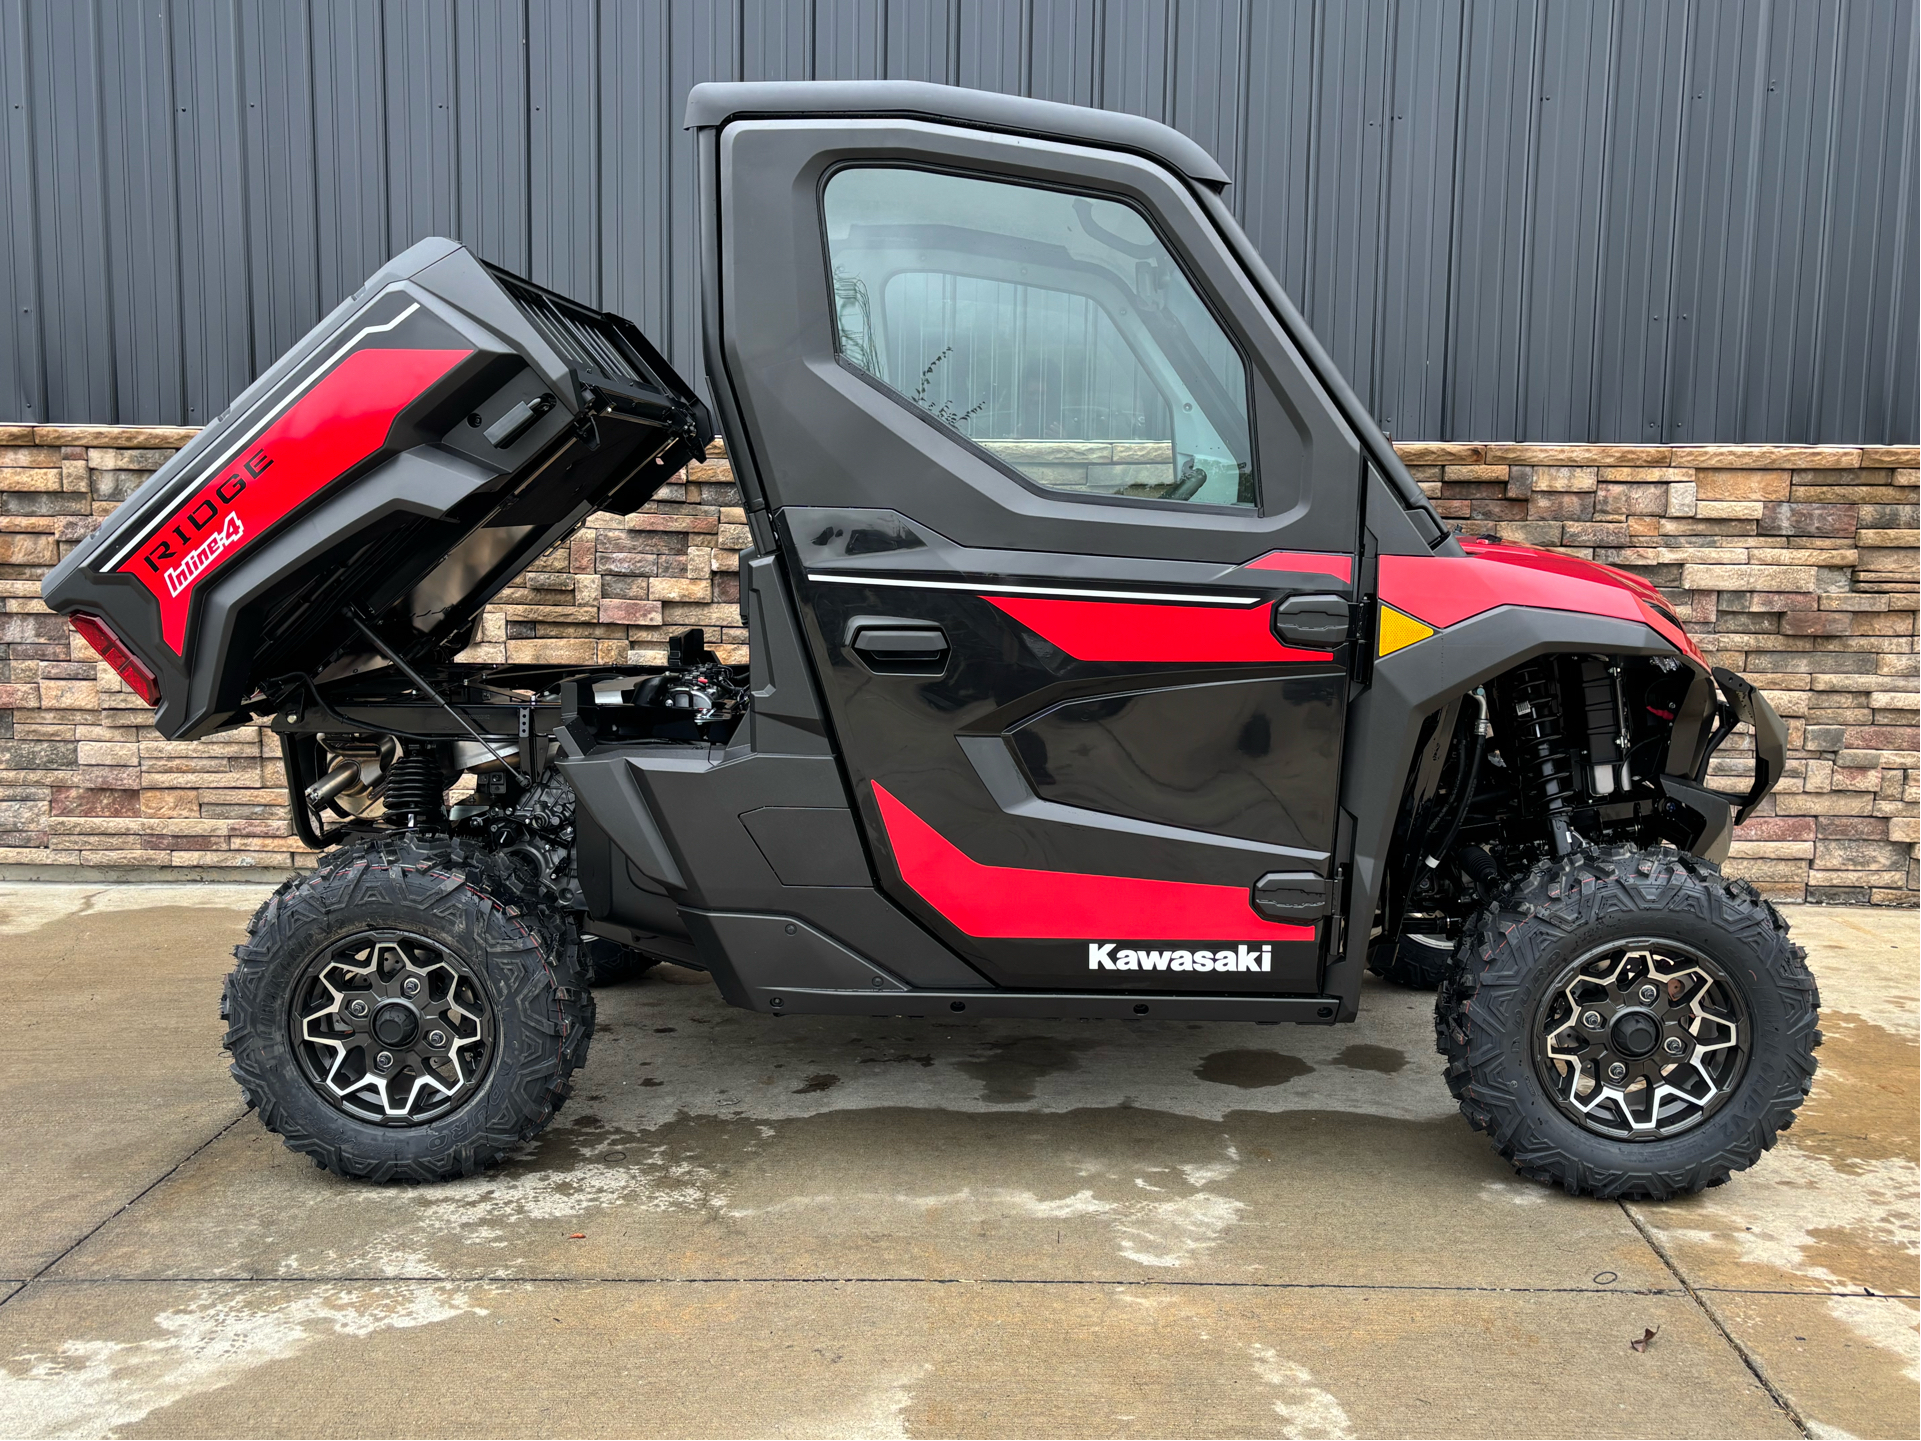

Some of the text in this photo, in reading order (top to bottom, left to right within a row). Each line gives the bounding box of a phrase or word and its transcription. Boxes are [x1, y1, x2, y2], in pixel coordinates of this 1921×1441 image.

[143, 448, 275, 573] RIDGE
[163, 510, 245, 598] Inline-4
[1088, 943, 1272, 972] Kawasaki
[1511, 949, 1562, 1029] DURO
[425, 1080, 505, 1152] DURO
